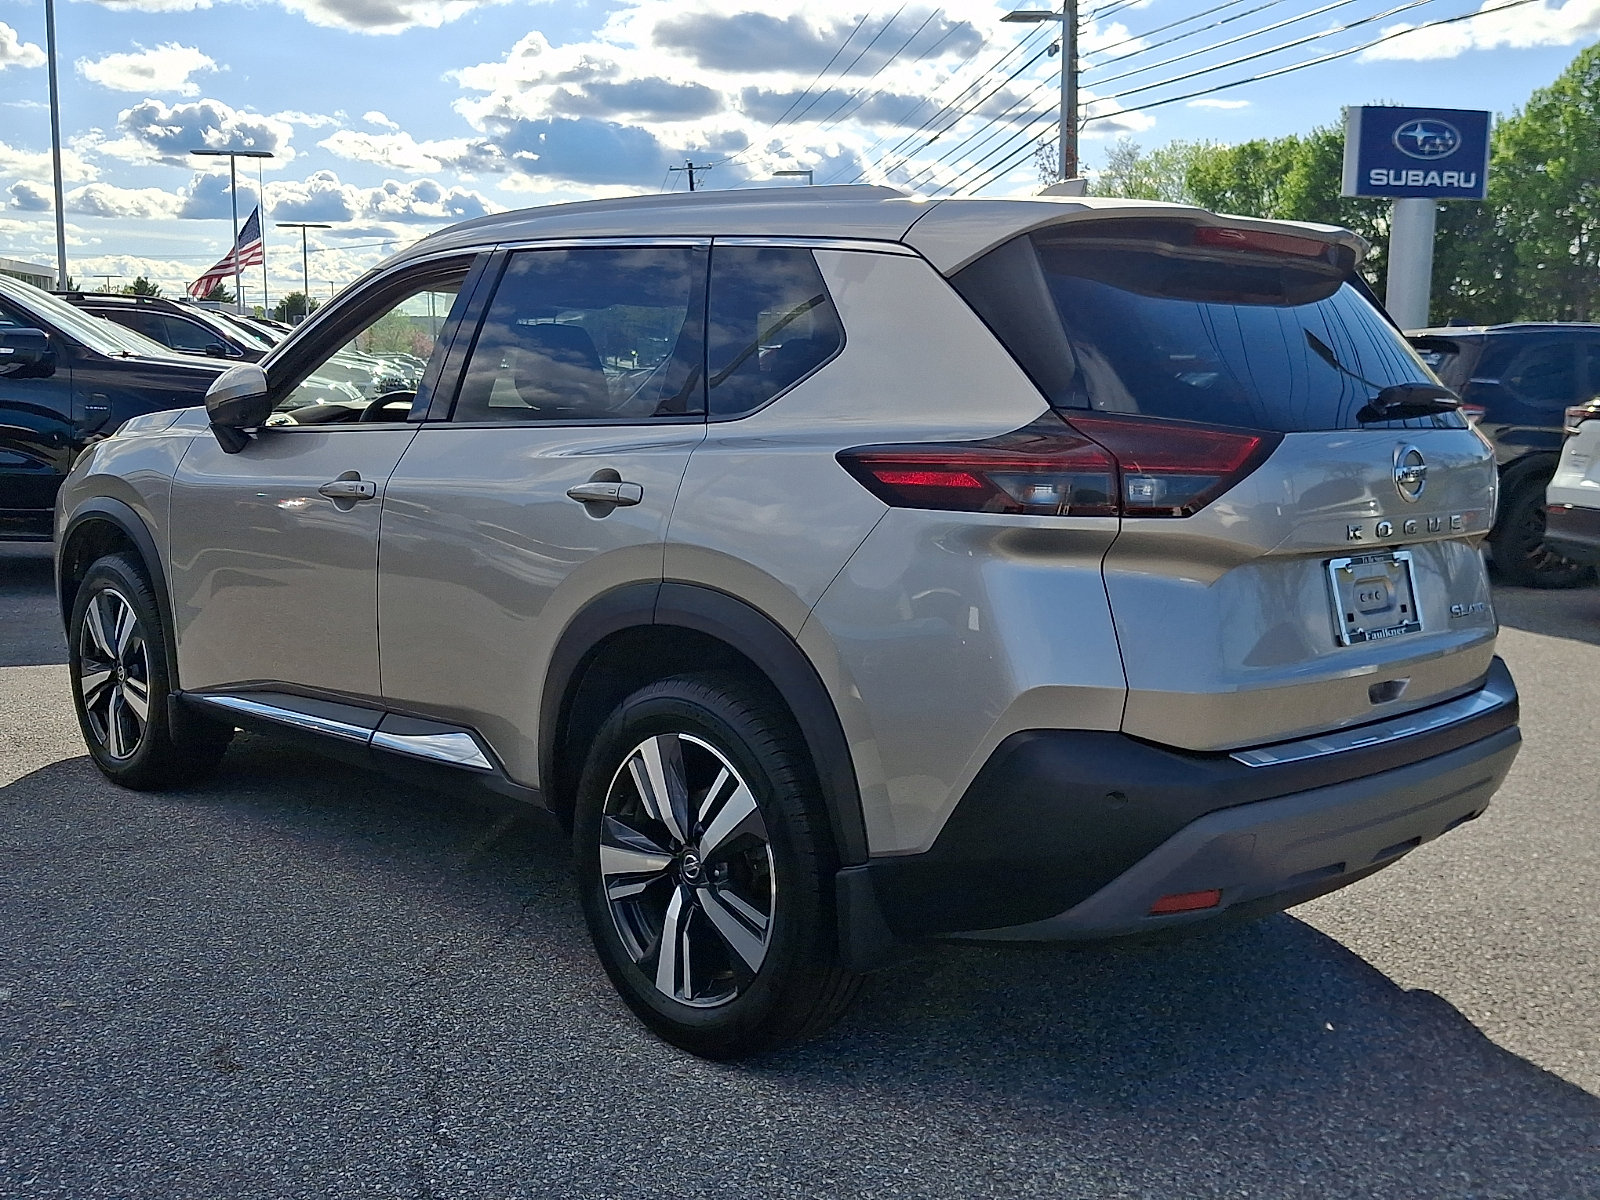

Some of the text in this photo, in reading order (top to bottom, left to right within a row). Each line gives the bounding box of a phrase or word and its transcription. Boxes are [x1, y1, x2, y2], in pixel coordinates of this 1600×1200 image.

[1369, 168, 1476, 188] SUBARU
[1346, 514, 1462, 541] ROGUE
[1365, 626, 1406, 641] Faulkner
